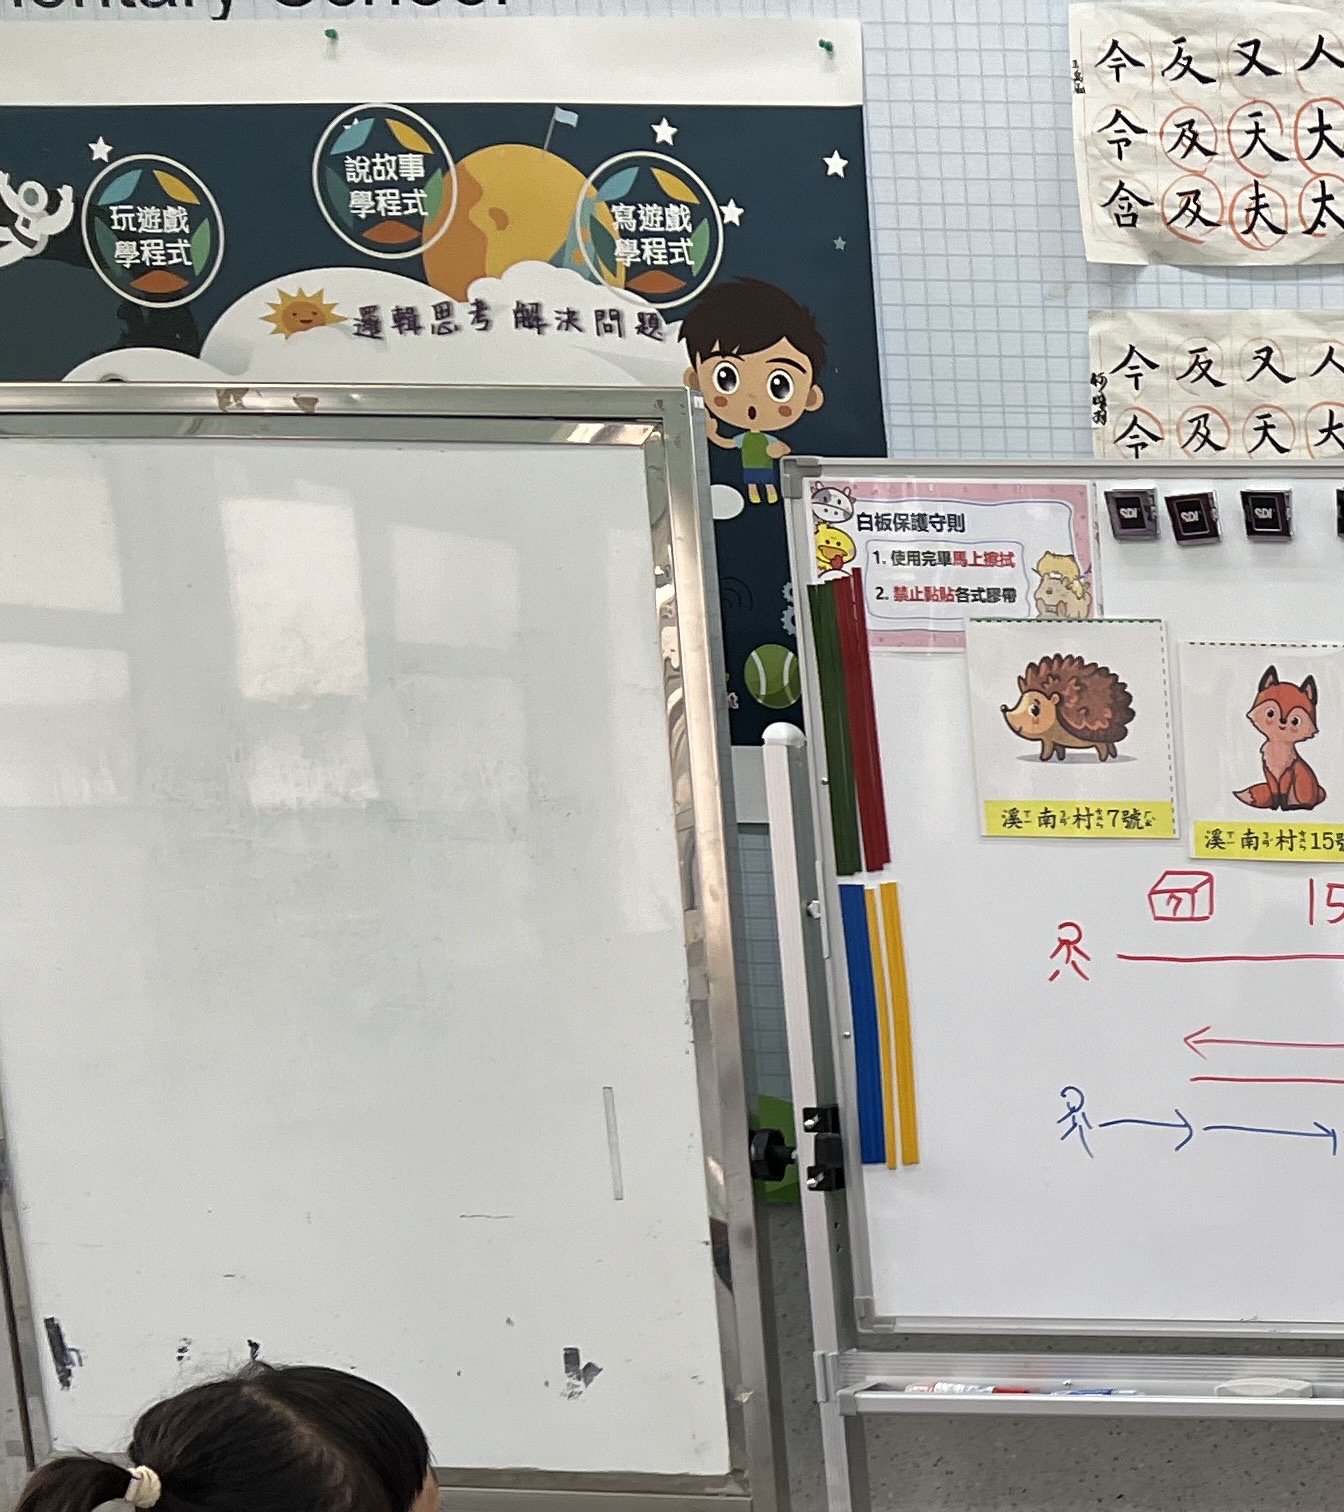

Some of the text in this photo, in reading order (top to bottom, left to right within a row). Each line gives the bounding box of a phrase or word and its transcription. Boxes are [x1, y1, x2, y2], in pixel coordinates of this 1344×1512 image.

[345, 154, 426, 185] 說故事
[349, 188, 429, 219] 學程式
[611, 202, 694, 236] 寫遊戲
[110, 203, 191, 236] 玩遊戲
[113, 238, 193, 269] 學程式
[614, 238, 695, 268] 學程式
[512, 301, 668, 340] 解決問題
[857, 512, 966, 533] 白板保護守則
[1119, 507, 1139, 520] SDI
[1180, 510, 1200, 524] SDI
[1254, 508, 1273, 520] SDI
